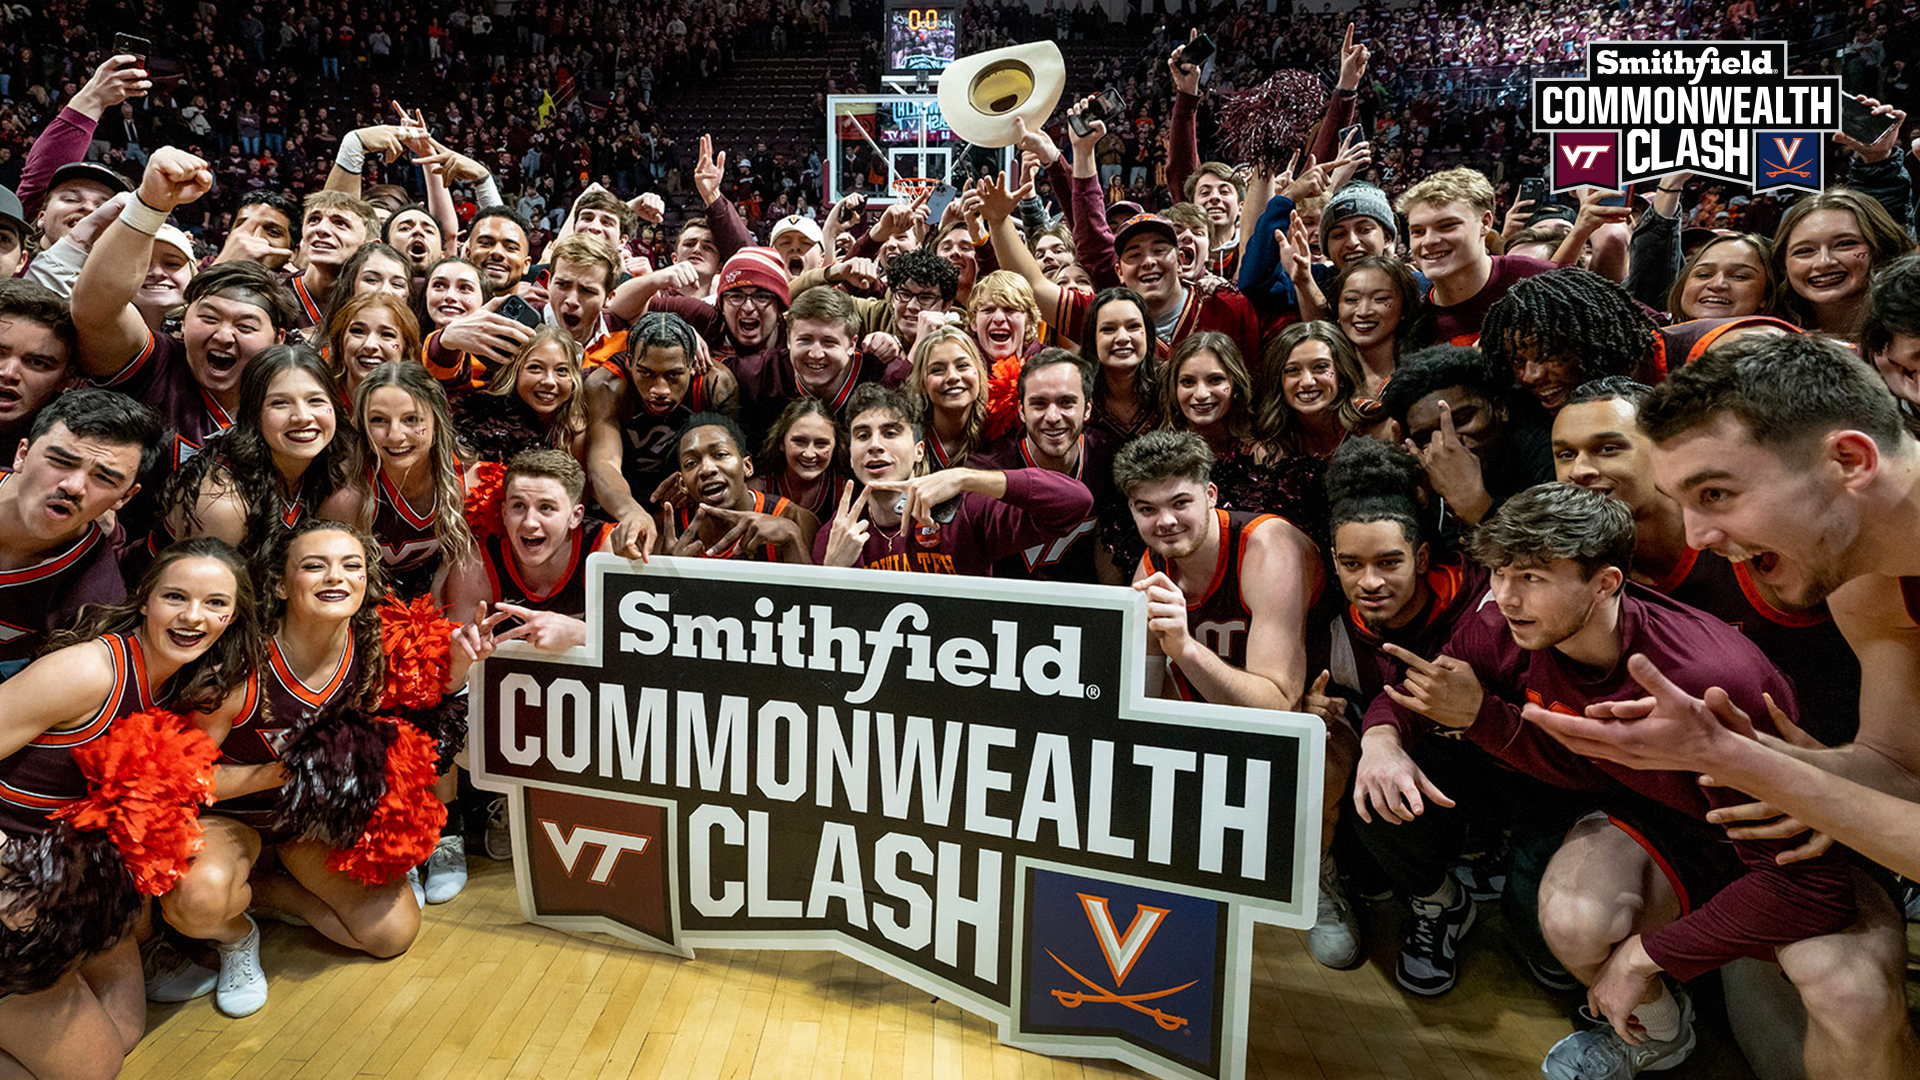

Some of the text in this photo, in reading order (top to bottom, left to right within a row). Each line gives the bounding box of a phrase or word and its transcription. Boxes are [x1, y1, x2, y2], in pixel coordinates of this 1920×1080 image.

[499, 671, 1271, 882] COMMONWEALTH
[537, 818, 652, 886] VT
[689, 803, 1003, 986] CLASH
[1075, 892, 1173, 989] V
